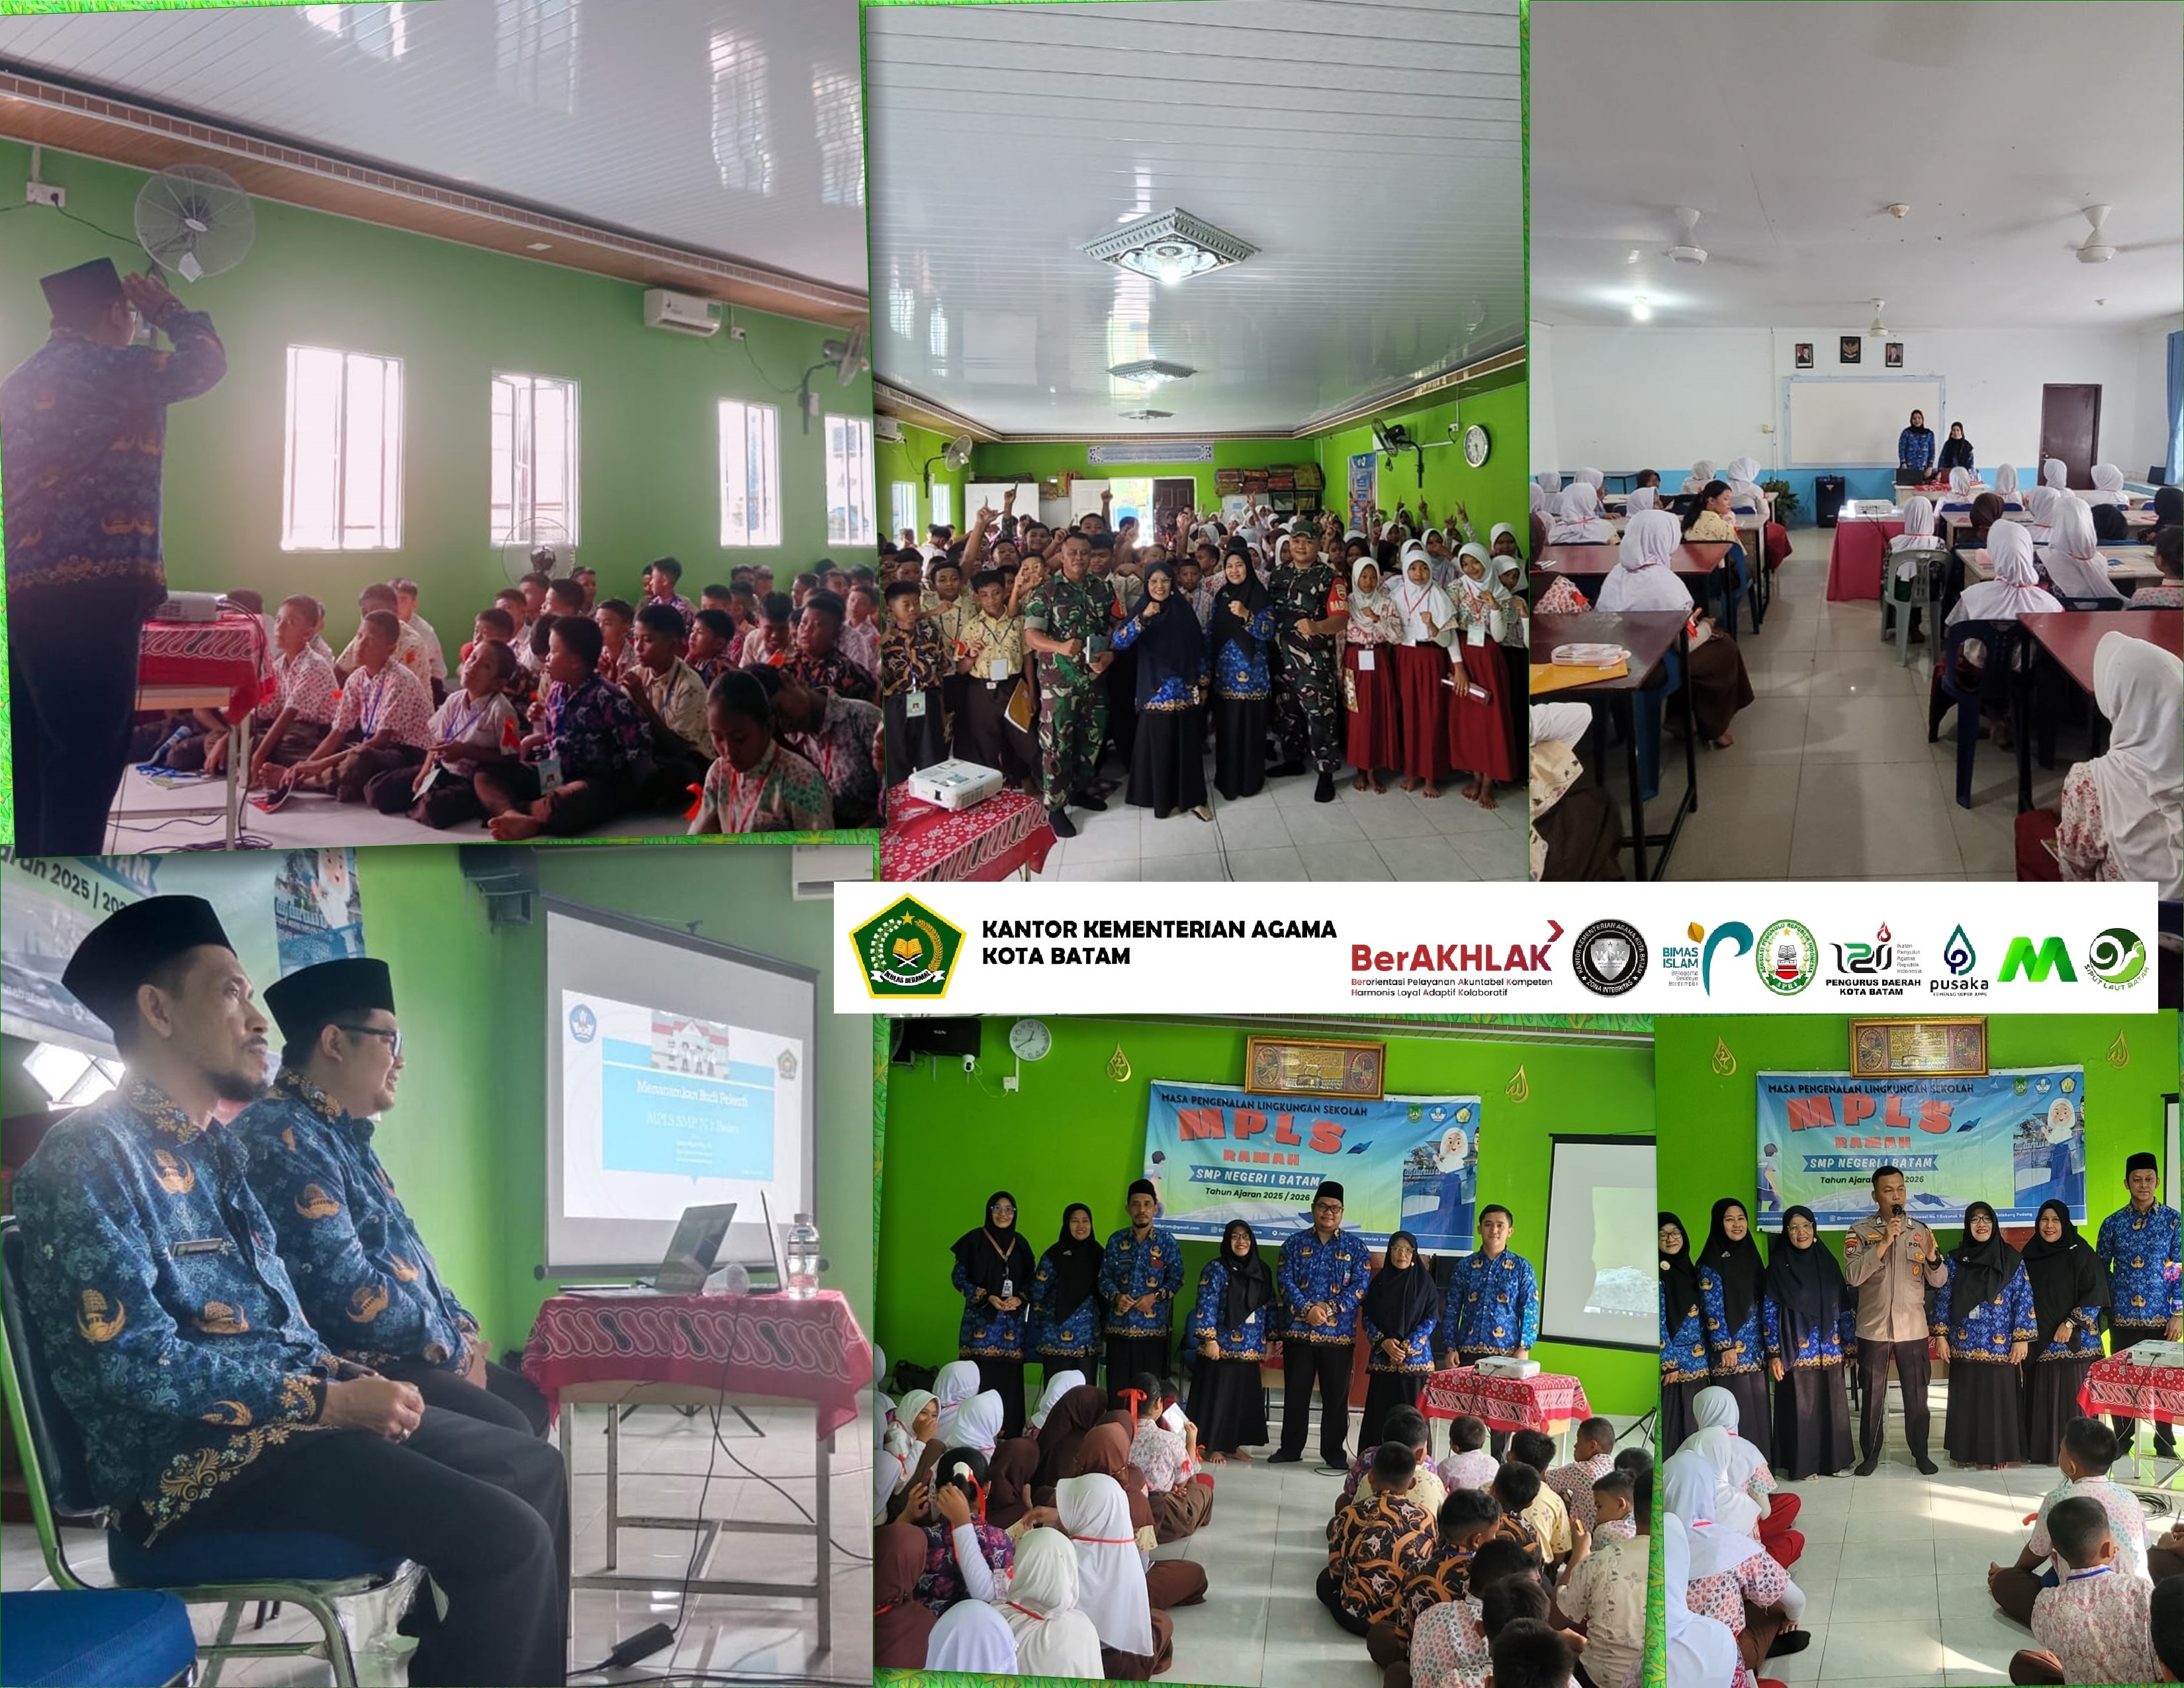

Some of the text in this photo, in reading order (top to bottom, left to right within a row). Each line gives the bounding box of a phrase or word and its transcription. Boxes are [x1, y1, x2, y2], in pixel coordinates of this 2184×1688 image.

[50, 863, 90, 900] 2025
[1768, 1084, 1974, 1094] MASA PENGENALAN LINGKUNGAN SEKOLAH
[1161, 1093, 1367, 1116] MASA PENGENALAN LINGKUNGAN SEKOLAH
[1787, 1094, 1955, 1134] MPLS
[1178, 1107, 1346, 1154] MPLS
[1835, 1137, 1911, 1149] RAMAH
[1223, 1149, 1299, 1166] RAMAH
[1810, 1158, 1835, 1168] SMP
[1838, 1158, 1880, 1168] NEGERI
[1893, 1158, 1932, 1168] BATAM
[1197, 1168, 1320, 1187] SMP NEGERI 1 BATAM
[1848, 1176, 1872, 1185] Ajara
[1205, 1187, 1232, 1196] Tahun
[1233, 1189, 1261, 1199] Ajaran
[1285, 1192, 1289, 1201] /
[1291, 1193, 1310, 1201] 2026
